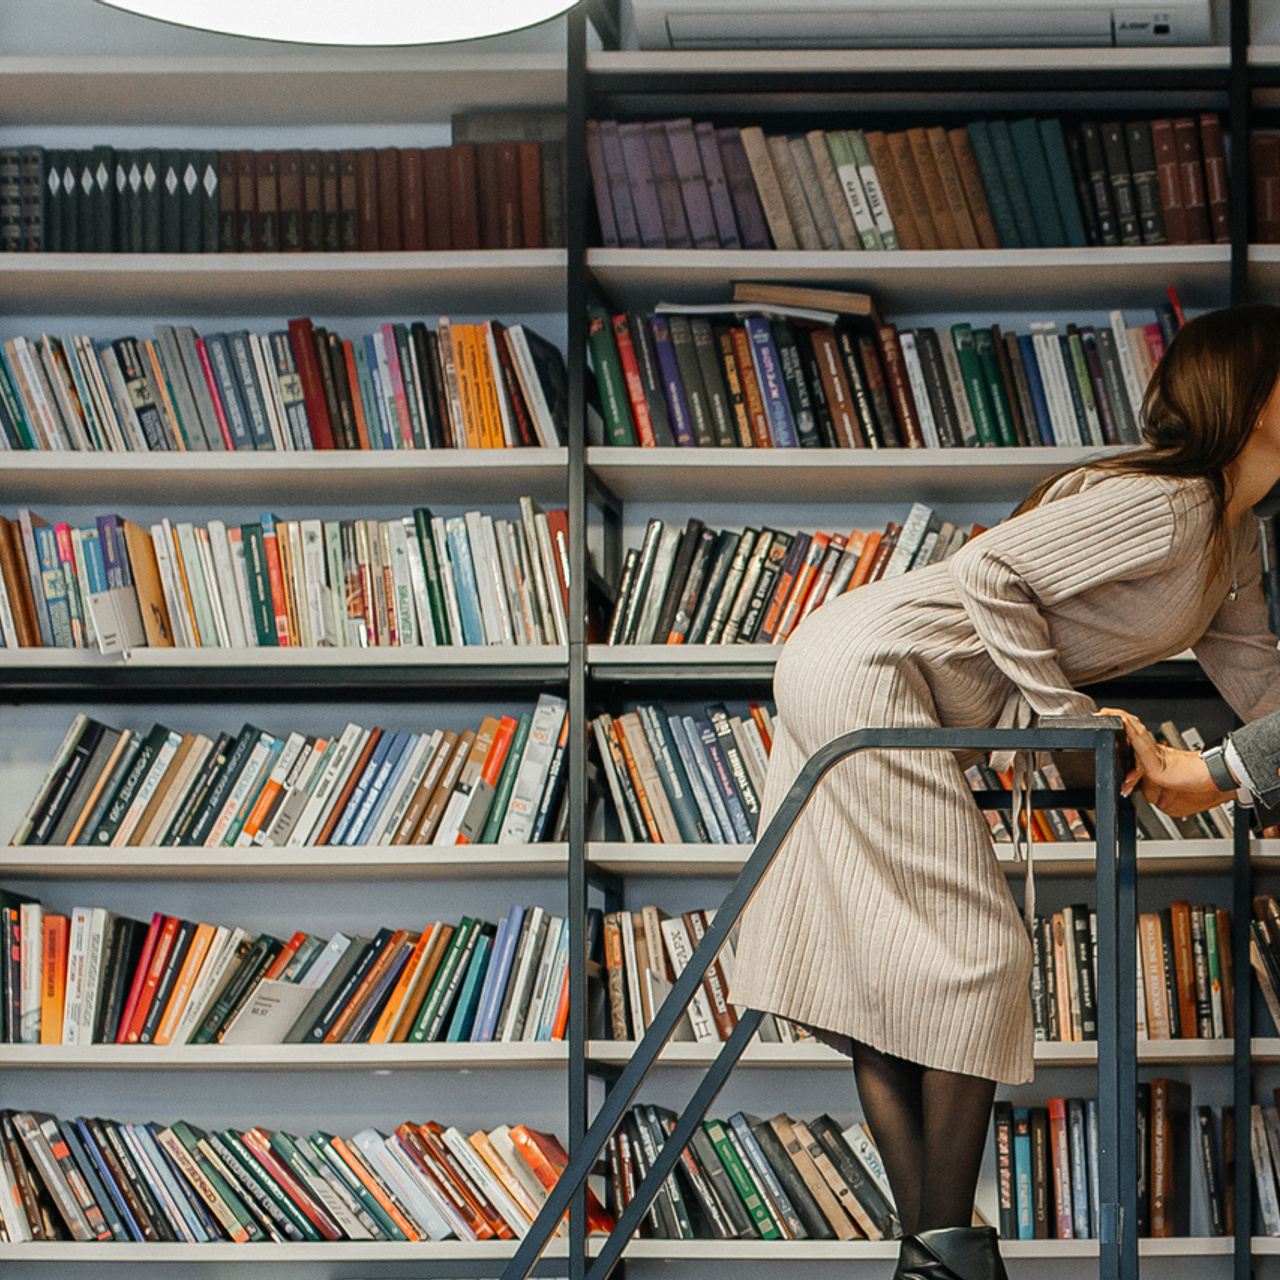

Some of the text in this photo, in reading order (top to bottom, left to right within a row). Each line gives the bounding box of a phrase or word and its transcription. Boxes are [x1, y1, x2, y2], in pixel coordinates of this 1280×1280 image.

[759, 347, 780, 399] ЖРЕЦОВ
[396, 584, 413, 645] ПЕДИАТРИЯ
[533, 731, 549, 743] 100
[231, 758, 258, 802] БОЛЕЗНИ
[1143, 921, 1158, 963] ВОСТОК
[1081, 968, 1092, 1007] ДРЕВНИЙ
[1148, 975, 1161, 1017] РОССИЯ
[162, 1136, 220, 1203] СЕМЬЕВЕДЕНИЕ
[1154, 1099, 1163, 1198] ИСТОРИЯ ДРЕВНЕГО РИМА
